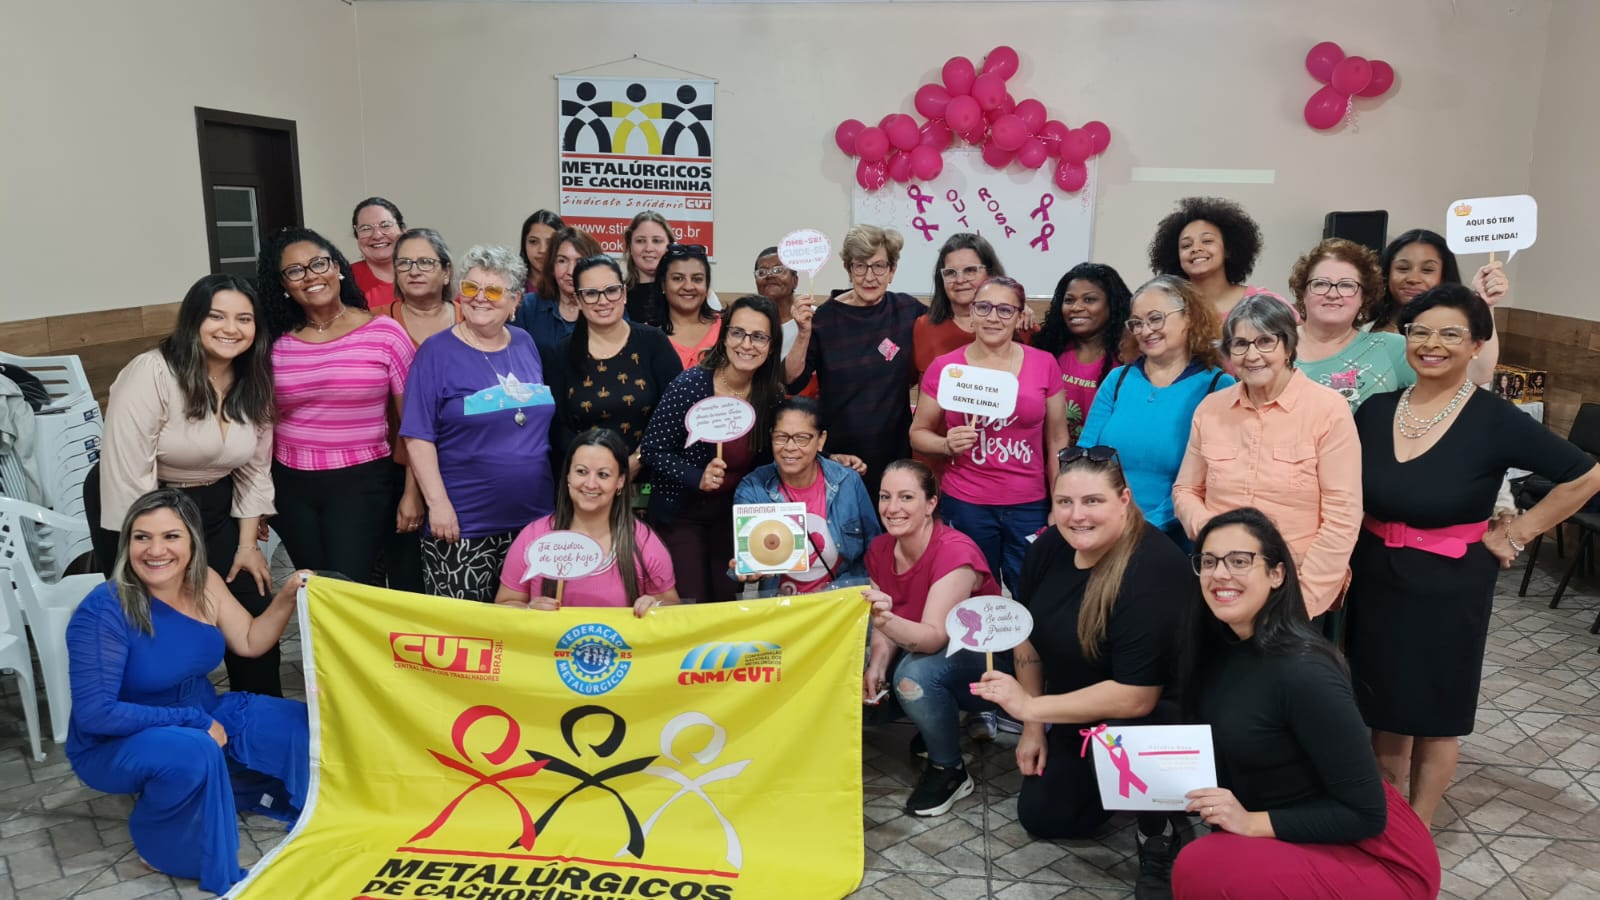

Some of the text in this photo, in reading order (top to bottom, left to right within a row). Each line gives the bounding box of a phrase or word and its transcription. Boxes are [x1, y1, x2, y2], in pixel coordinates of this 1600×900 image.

[562, 160, 712, 179] METALÚRGICOS
[562, 175, 712, 192] DE CACHOEIRINHA
[562, 195, 684, 209] Sindicato Solidário
[686, 199, 712, 209] CUT
[978, 187, 1016, 239] ROSA
[1486, 216, 1497, 225] SÓ
[1464, 232, 1518, 243] GENTE LINDA!
[956, 381, 973, 391] AQUI
[1062, 373, 1097, 388] NATURE
[952, 395, 1000, 408] GENTE LINDA!
[553, 542, 585, 551] cuidou
[539, 554, 551, 562] de
[575, 552, 599, 567] hoje?
[393, 634, 491, 672] CUT
[492, 640, 503, 675] BRASIL
[620, 651, 632, 659] RS
[559, 661, 629, 694] METALÚRGICOS
[375, 858, 734, 900] METALÚRGICOS
[360, 880, 411, 896] DE
